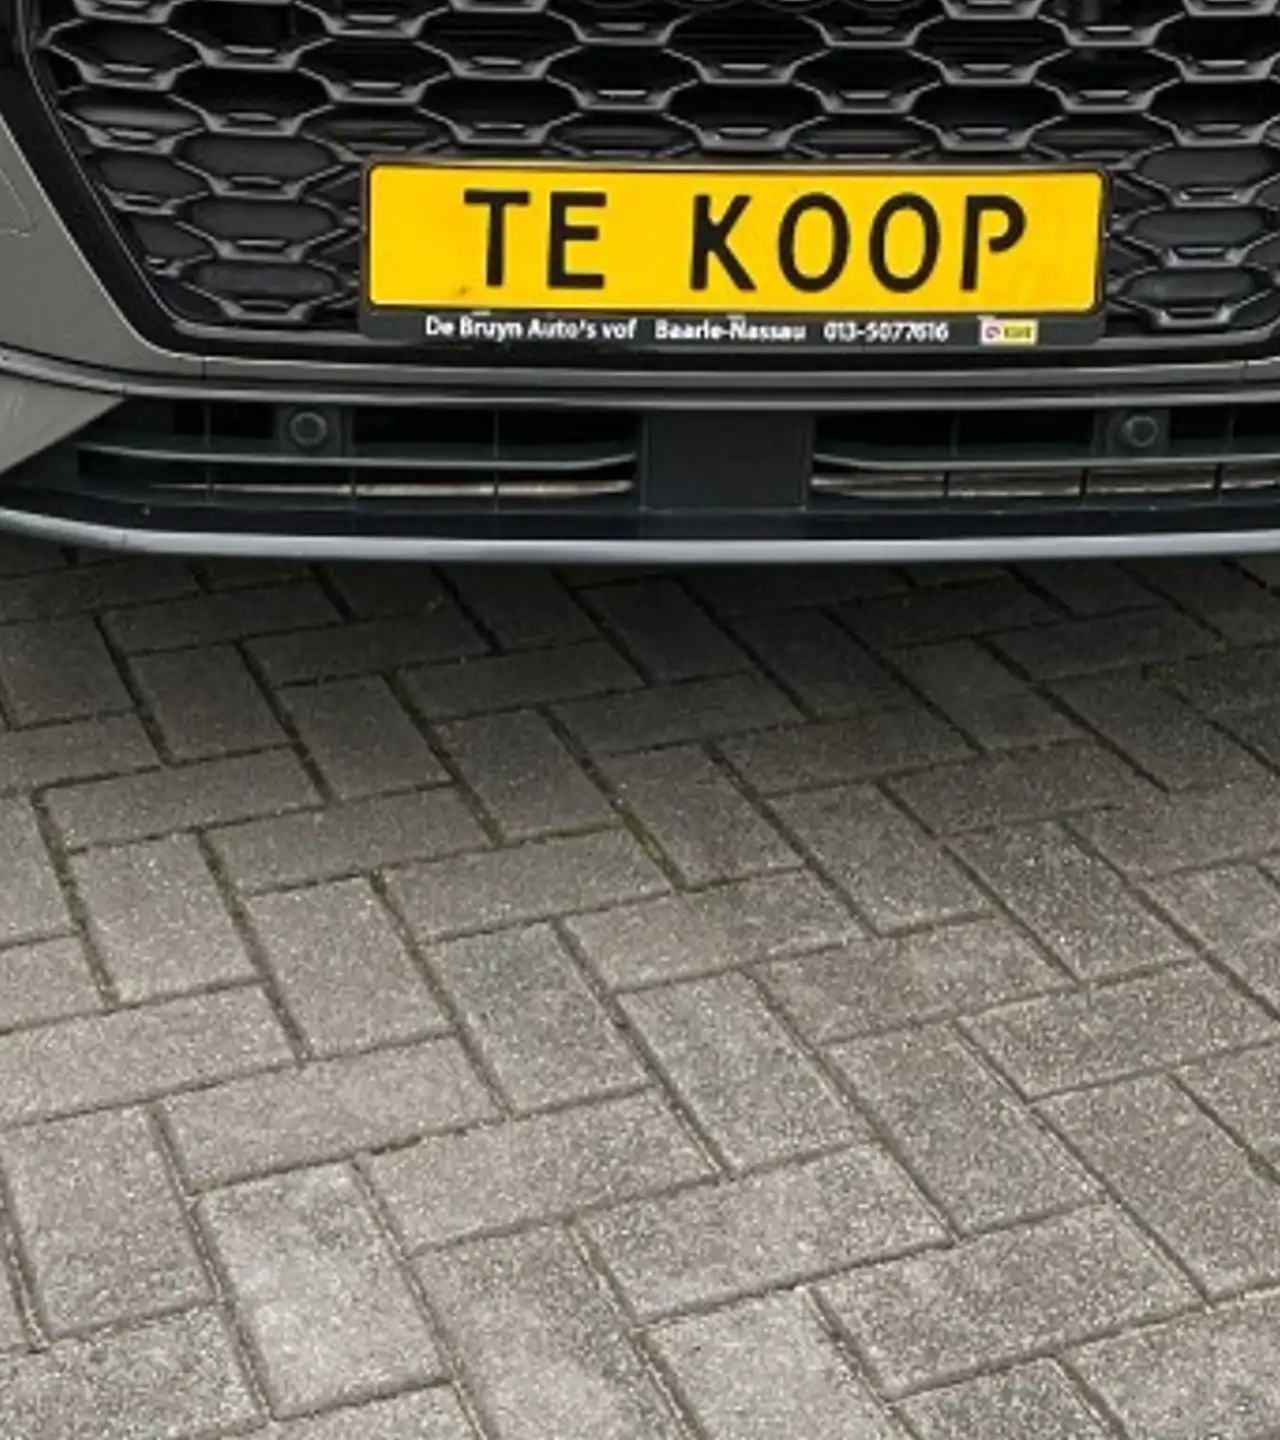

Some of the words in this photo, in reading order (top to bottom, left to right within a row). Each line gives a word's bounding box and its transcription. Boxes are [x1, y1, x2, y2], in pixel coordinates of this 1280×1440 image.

[463, 188, 607, 288] TE
[690, 192, 1028, 292] KOOP
[424, 315, 455, 337] De
[459, 316, 523, 342] Bruyn
[527, 317, 597, 340] Auto's
[601, 317, 638, 340] vof
[655, 317, 807, 341] Baarle-Nassau
